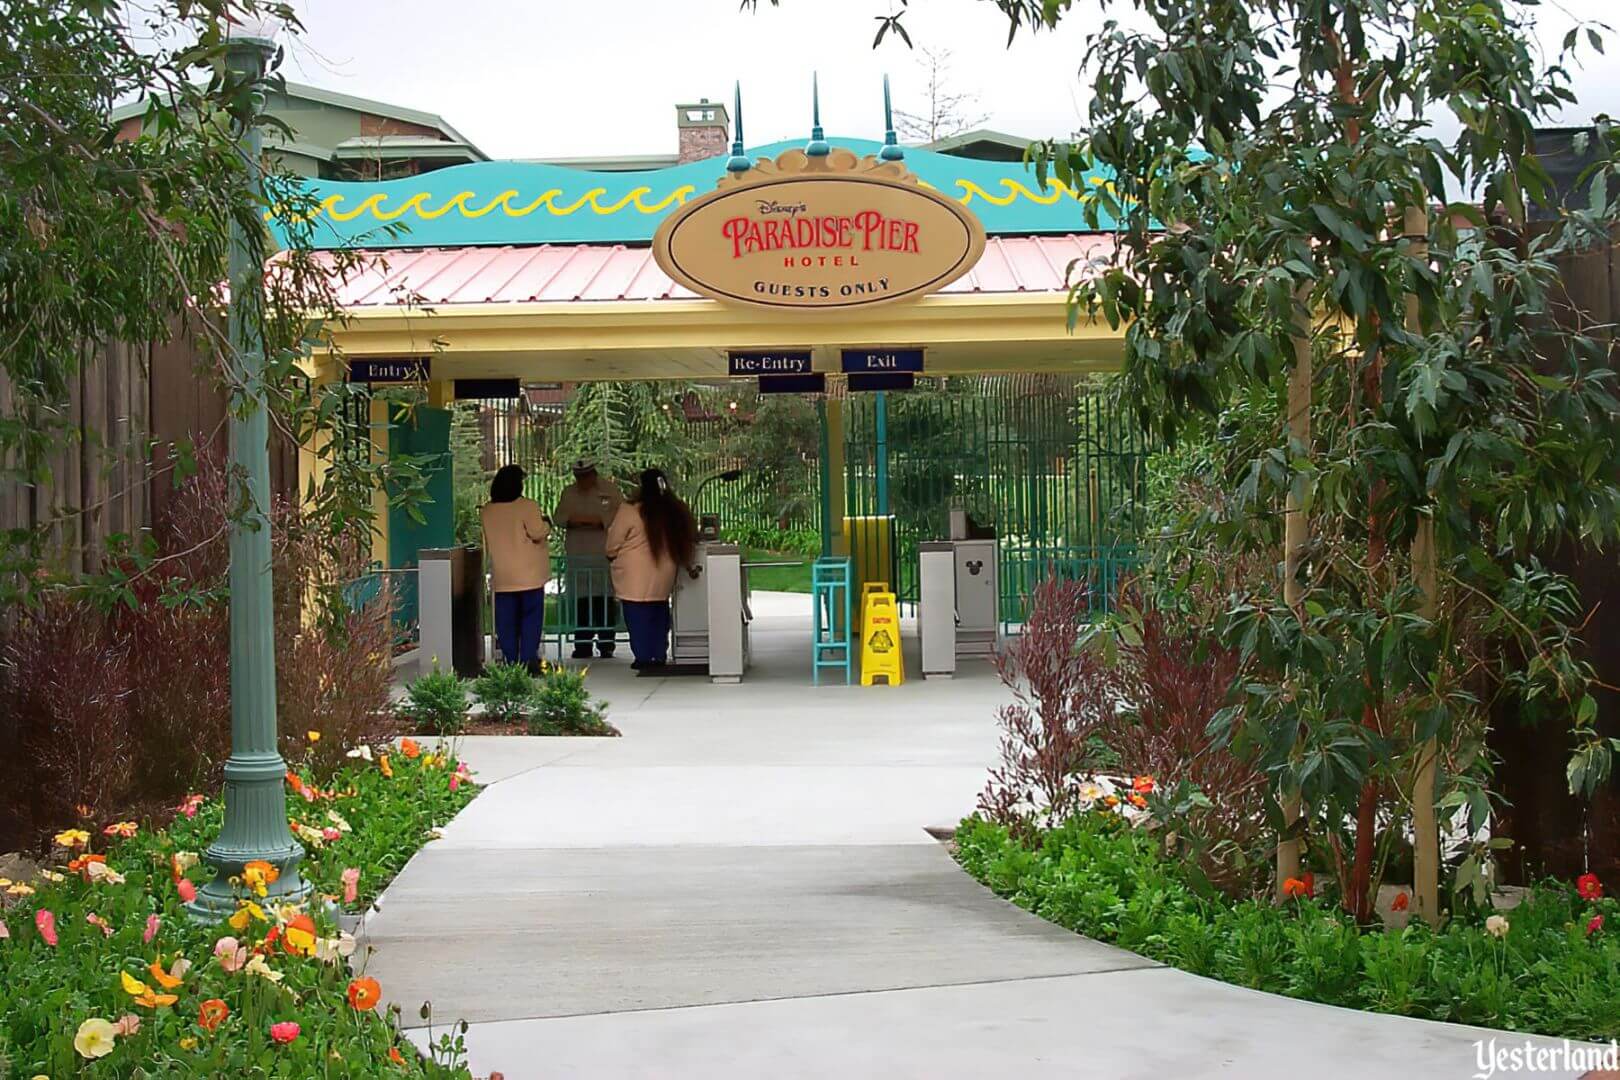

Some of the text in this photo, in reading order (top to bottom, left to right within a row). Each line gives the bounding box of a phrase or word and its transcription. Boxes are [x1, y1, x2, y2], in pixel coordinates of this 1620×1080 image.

[755, 199, 807, 217] Disney's
[722, 211, 921, 258] PARADISE PIER
[784, 256, 860, 268] HOTEL
[754, 278, 890, 297] GUESTS ONLY
[735, 357, 805, 372] Re-Entry
[867, 355, 897, 368] Exit
[369, 364, 412, 379] Entry
